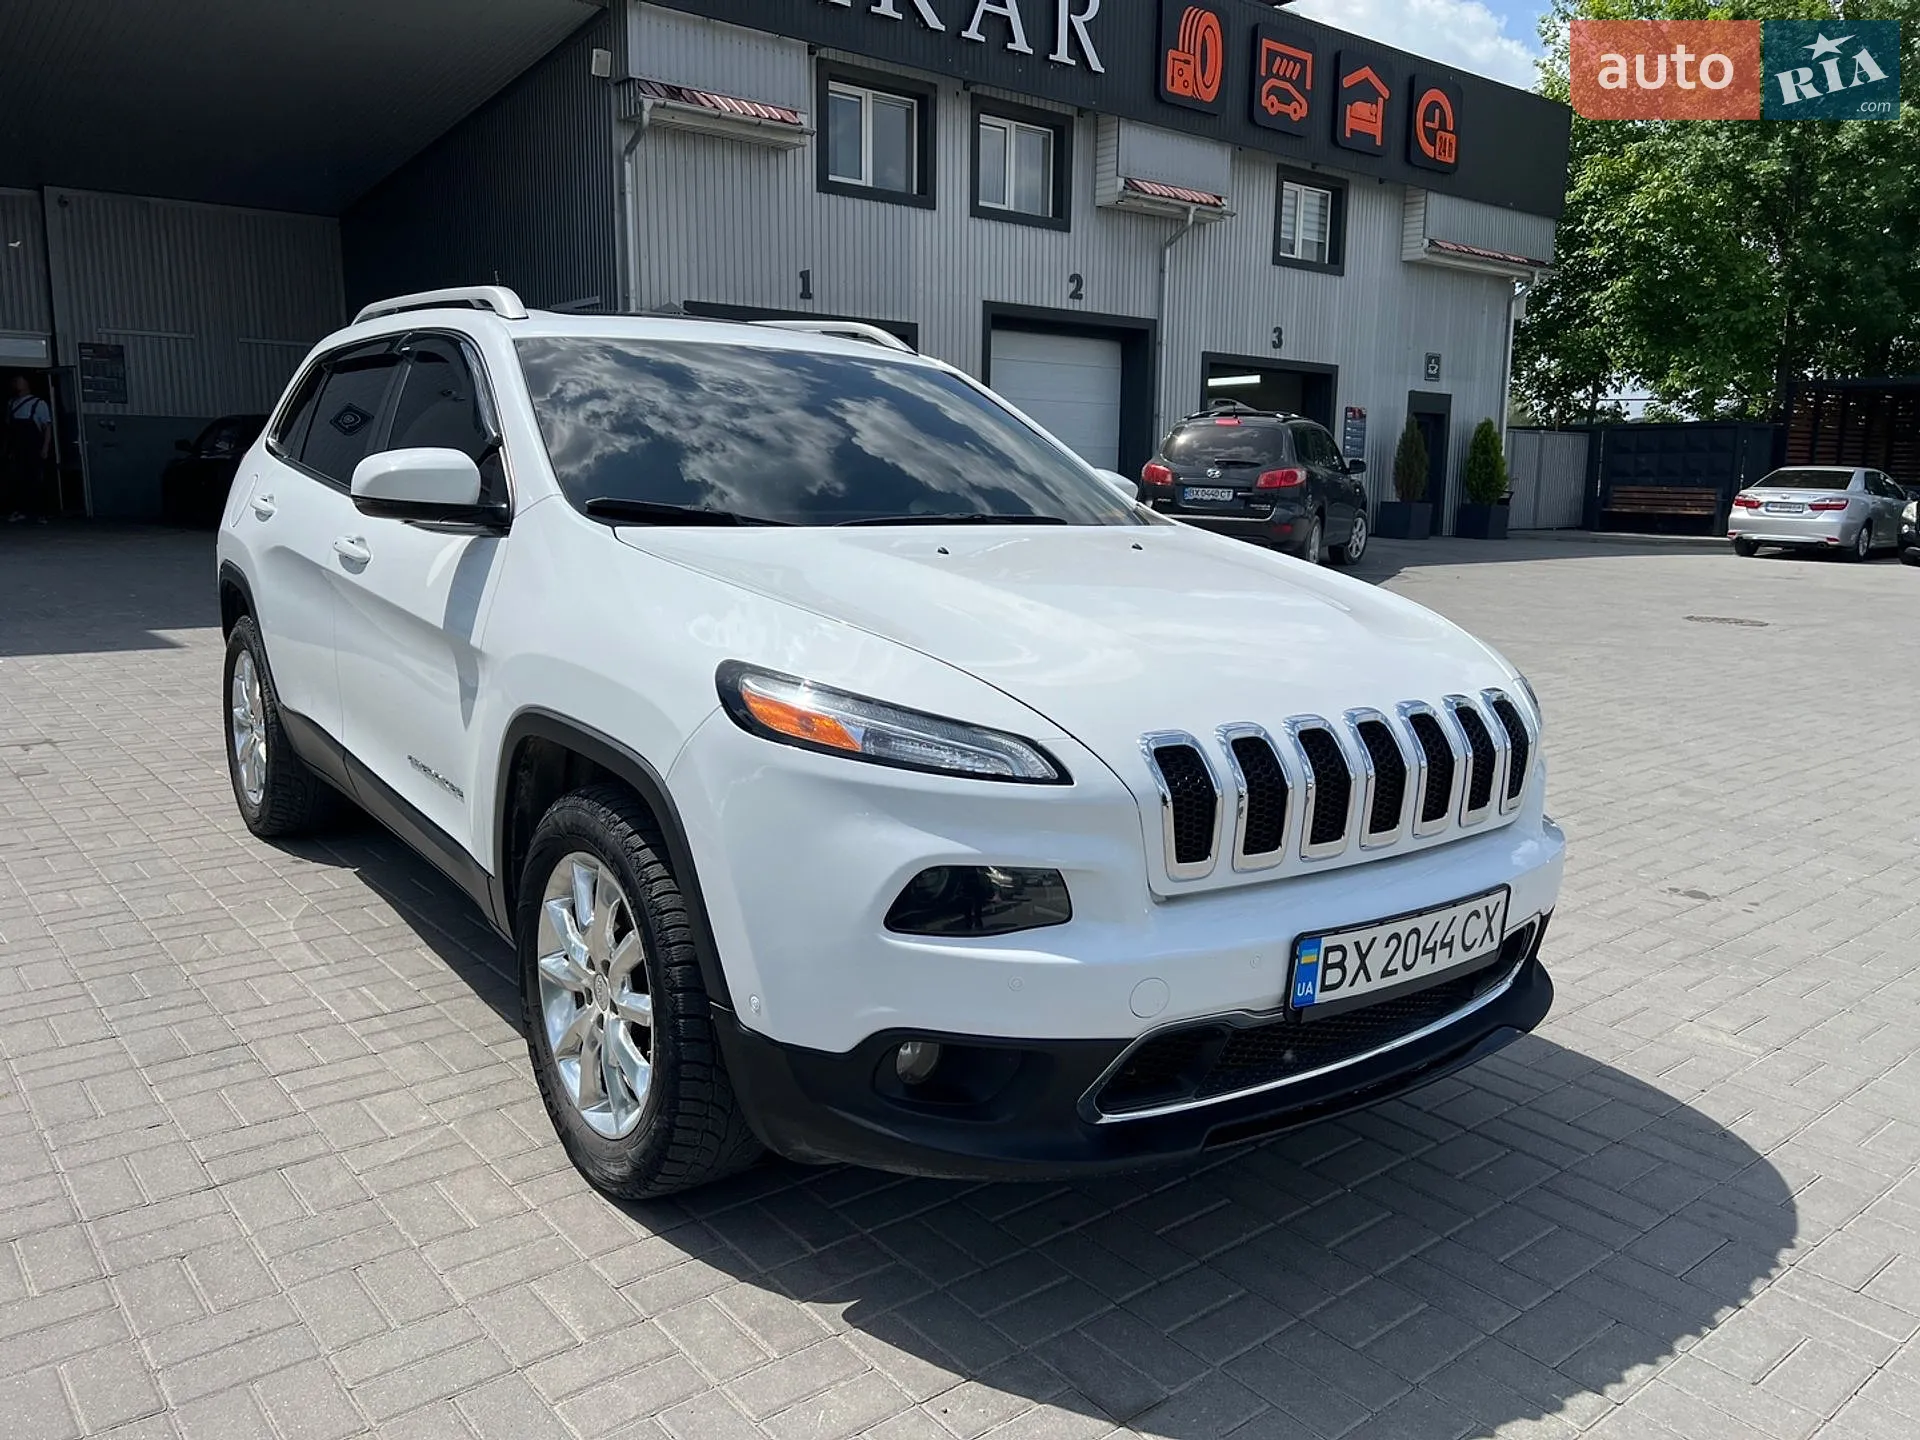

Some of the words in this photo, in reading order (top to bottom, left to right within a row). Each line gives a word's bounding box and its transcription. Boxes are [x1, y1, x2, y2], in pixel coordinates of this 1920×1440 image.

[799, 269, 812, 300] 1
[1069, 273, 1083, 300] 2
[1272, 326, 1284, 349] 3
[1319, 936, 1377, 993] BX
[1380, 916, 1457, 980] 2044
[1461, 901, 1500, 952] CX
[1297, 982, 1313, 996] UA
